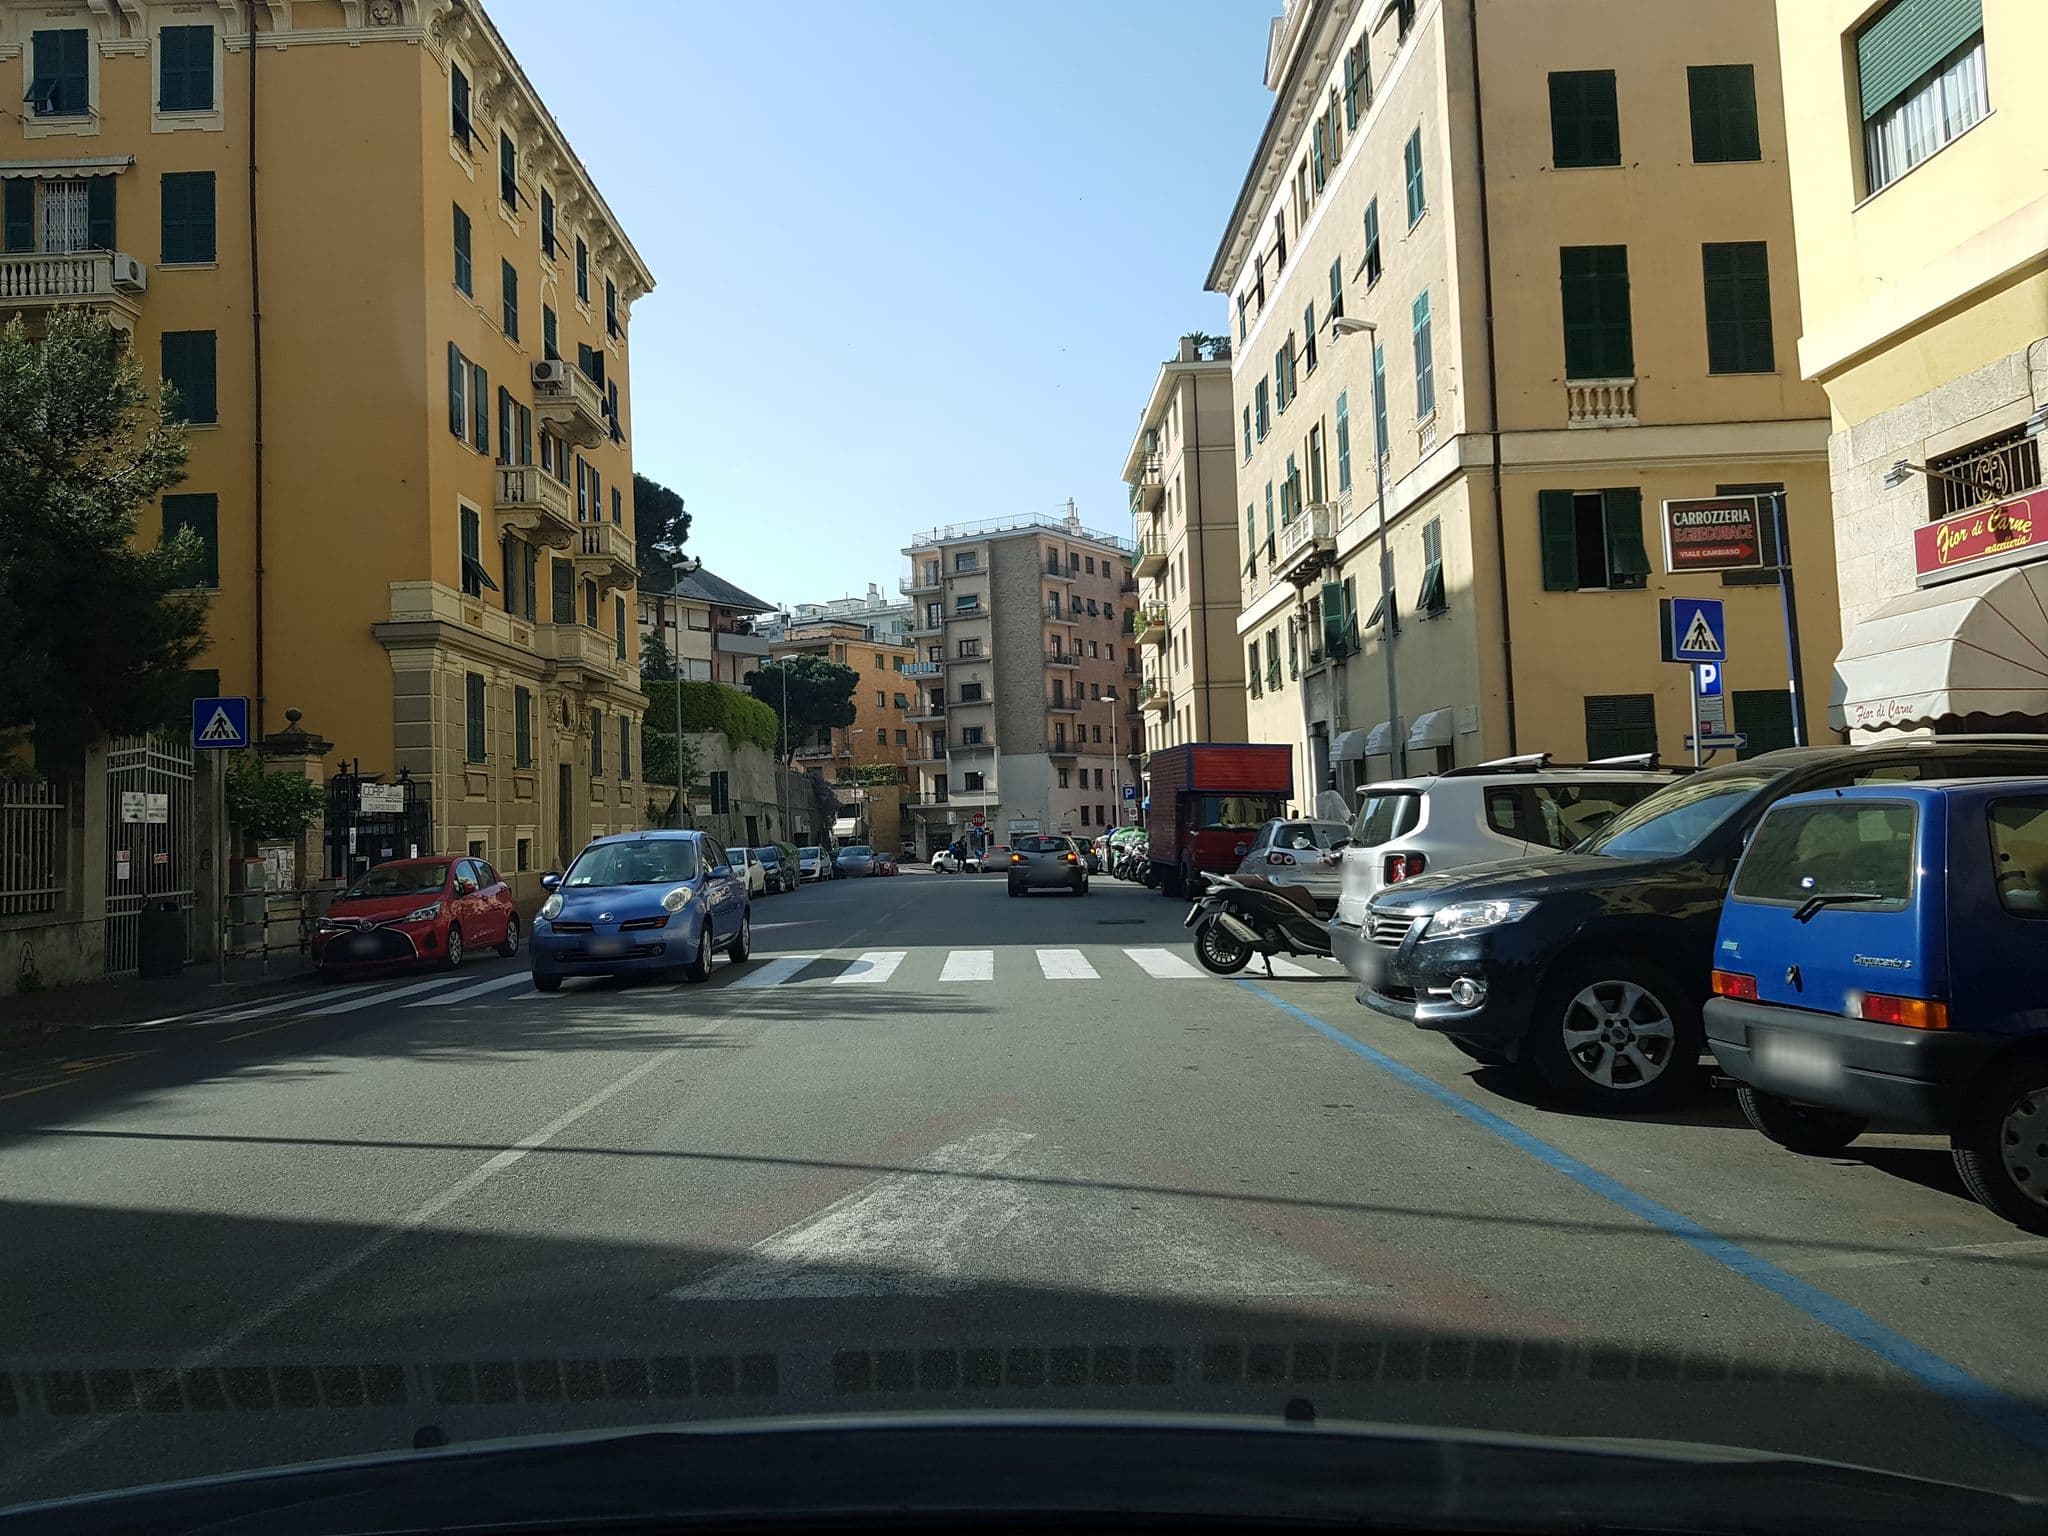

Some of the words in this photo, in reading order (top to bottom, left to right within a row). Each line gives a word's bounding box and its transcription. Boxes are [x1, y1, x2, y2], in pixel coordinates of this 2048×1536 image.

[1673, 509, 1751, 526] CARROZZERIA
[1937, 524, 1968, 564] Fior
[1971, 520, 1984, 537] di
[1987, 506, 2033, 533] Carne
[1679, 550, 1701, 558] VIALE
[1702, 548, 1741, 556] CAMBIASO
[1700, 664, 1716, 693] P
[1856, 705, 1874, 723] Fior
[1877, 703, 1885, 717] di
[1888, 700, 1913, 719] Carne
[1125, 788, 1133, 798] P
